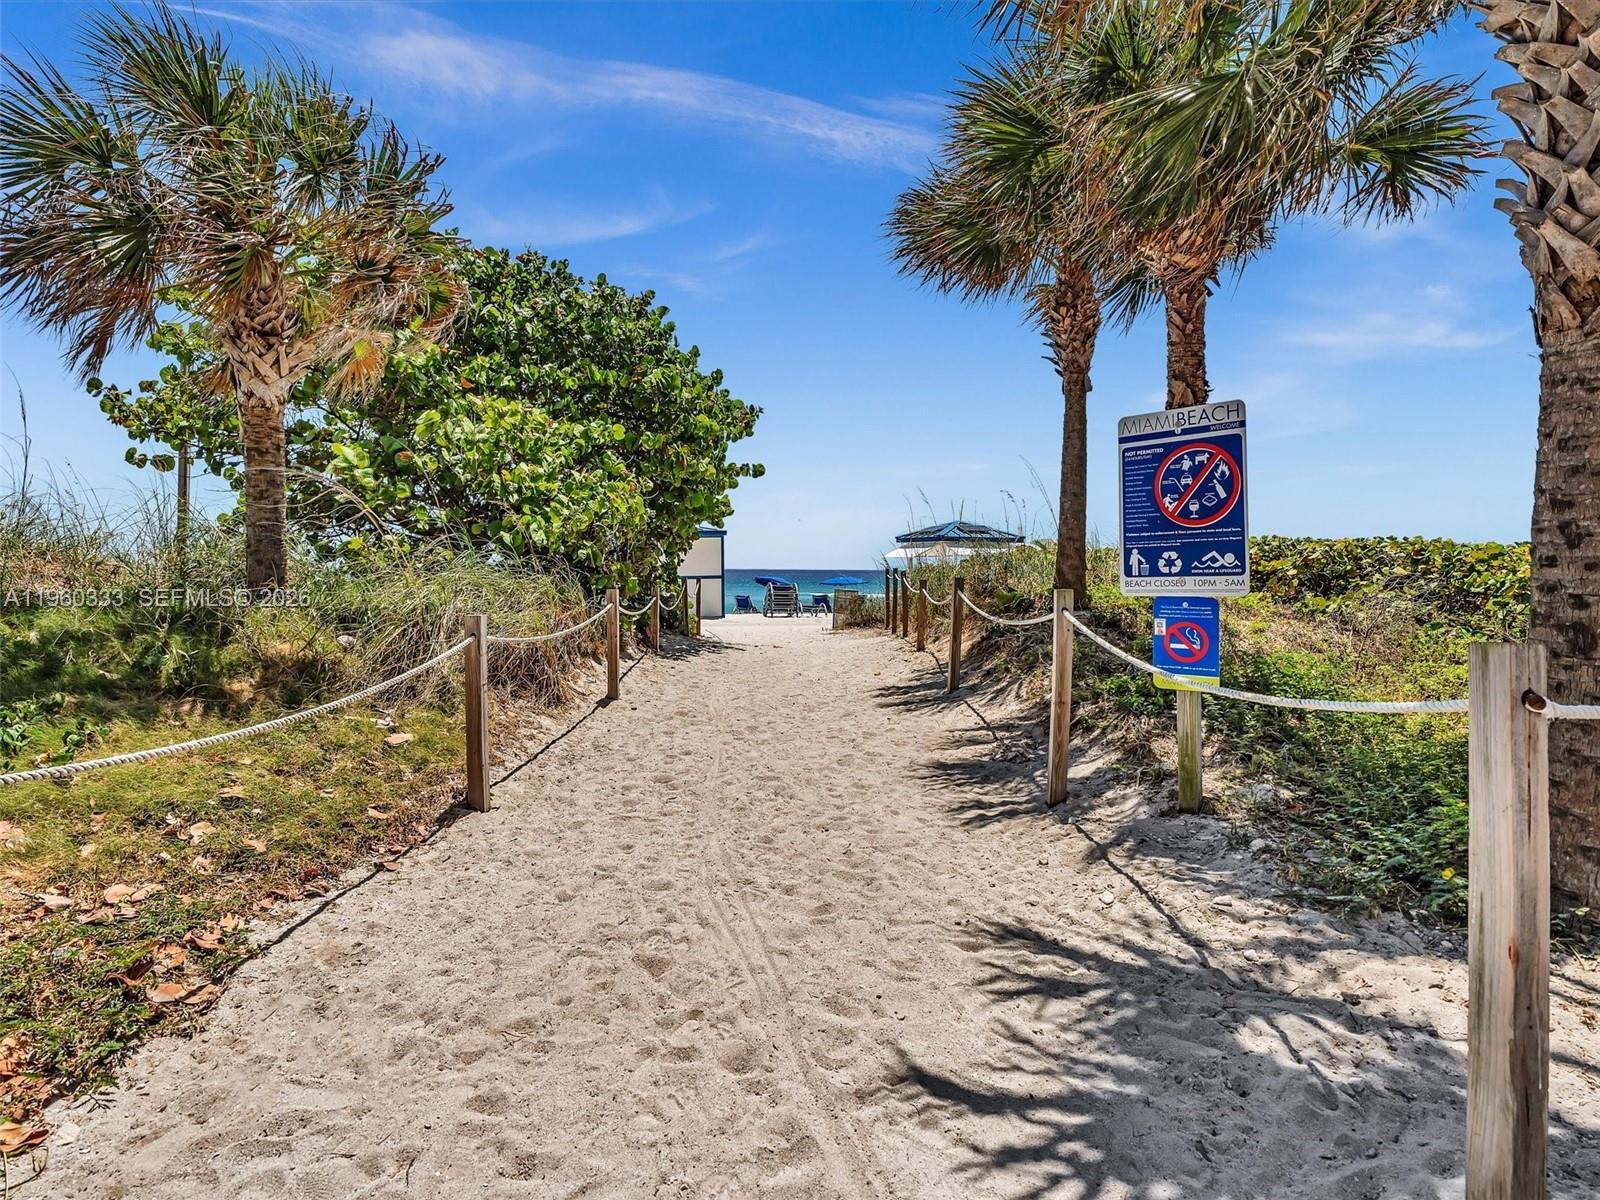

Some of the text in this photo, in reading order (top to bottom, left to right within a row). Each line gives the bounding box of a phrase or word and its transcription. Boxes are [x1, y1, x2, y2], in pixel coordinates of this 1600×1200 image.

[1210, 422, 1240, 431] WELCOME
[1137, 447, 1164, 456] PERMITTED
[1125, 580, 1151, 588] BEACH
[1154, 579, 1187, 587] CLOSED
[1193, 579, 1217, 587] 10PM
[1224, 579, 1246, 587] 5AM
